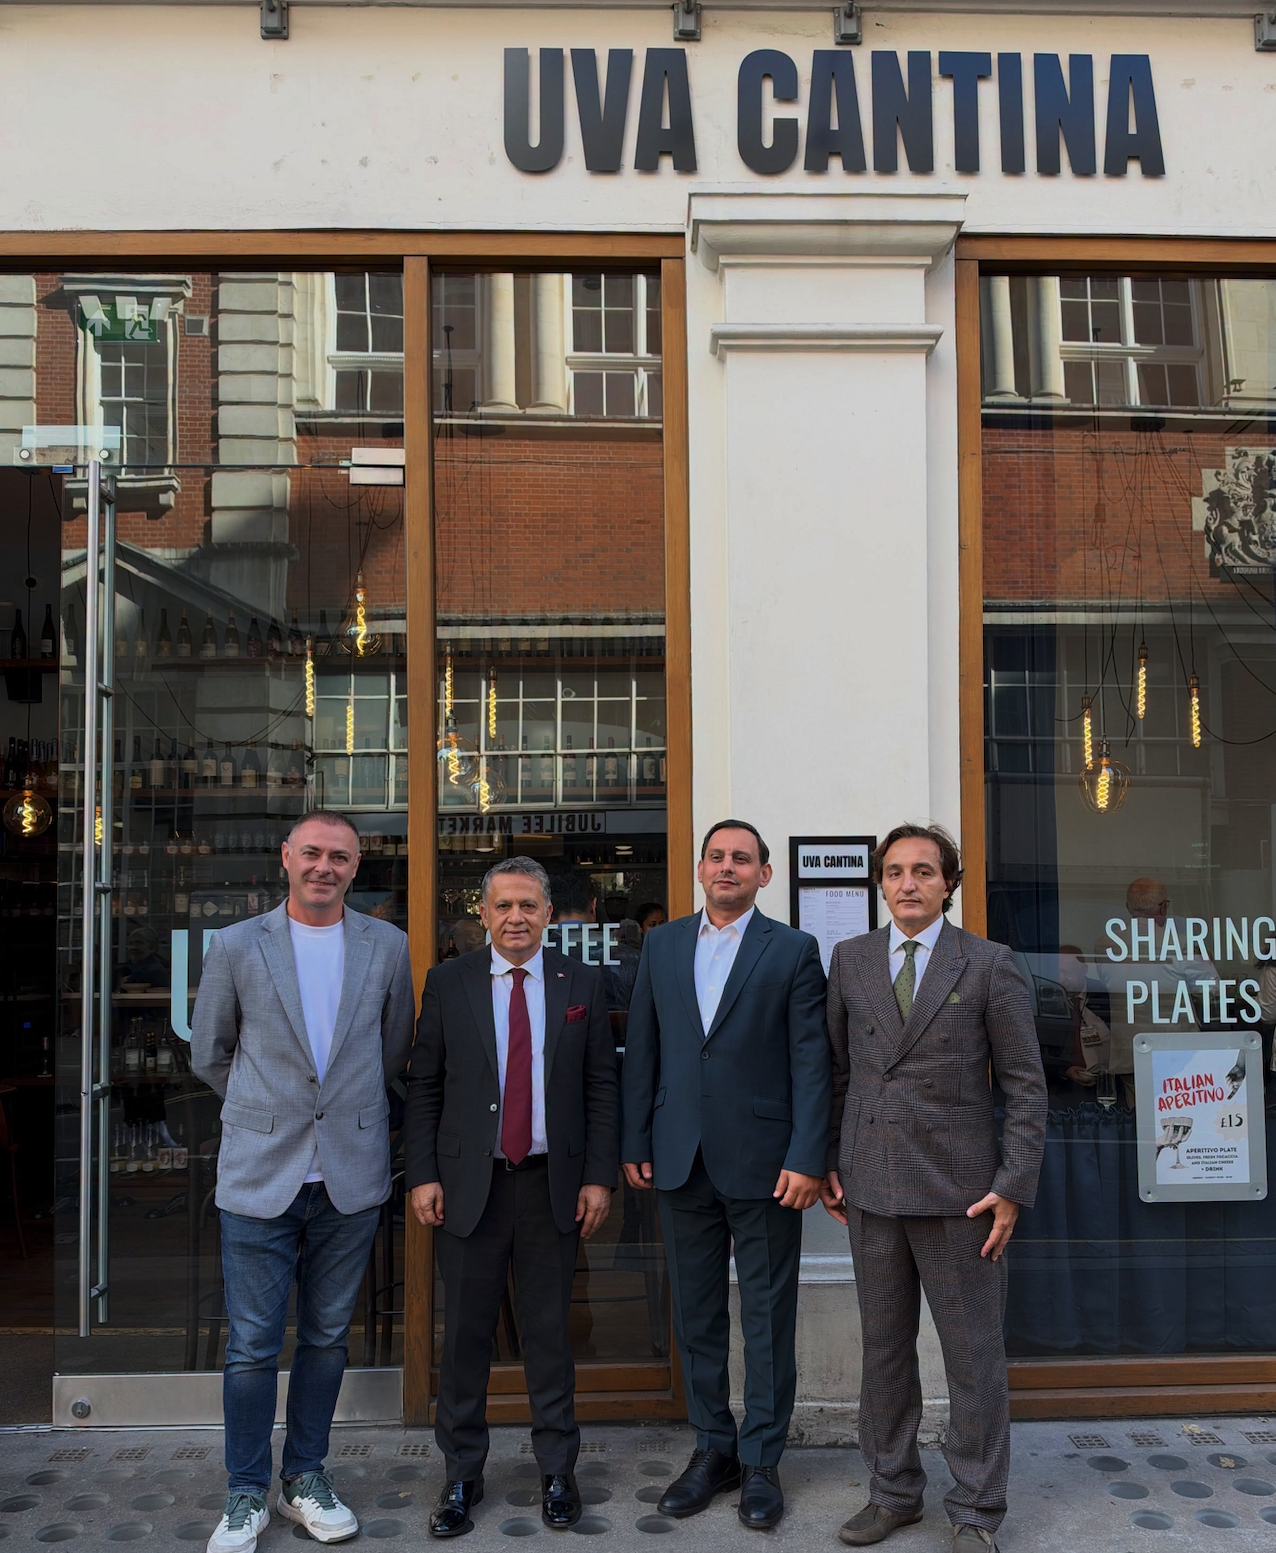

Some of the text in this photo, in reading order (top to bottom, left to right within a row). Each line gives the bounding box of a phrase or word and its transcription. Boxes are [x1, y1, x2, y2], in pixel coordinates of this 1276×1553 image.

[504, 48, 1166, 175] UVA CANTINA
[802, 855, 864, 868] UVA CANTINA
[1105, 916, 1276, 962] SHARING
[1126, 979, 1262, 1024] PLATES
[1162, 1073, 1214, 1094] ITALIAN
[1158, 1087, 1224, 1112] APERITIVO
[1220, 1113, 1243, 1128] £15
